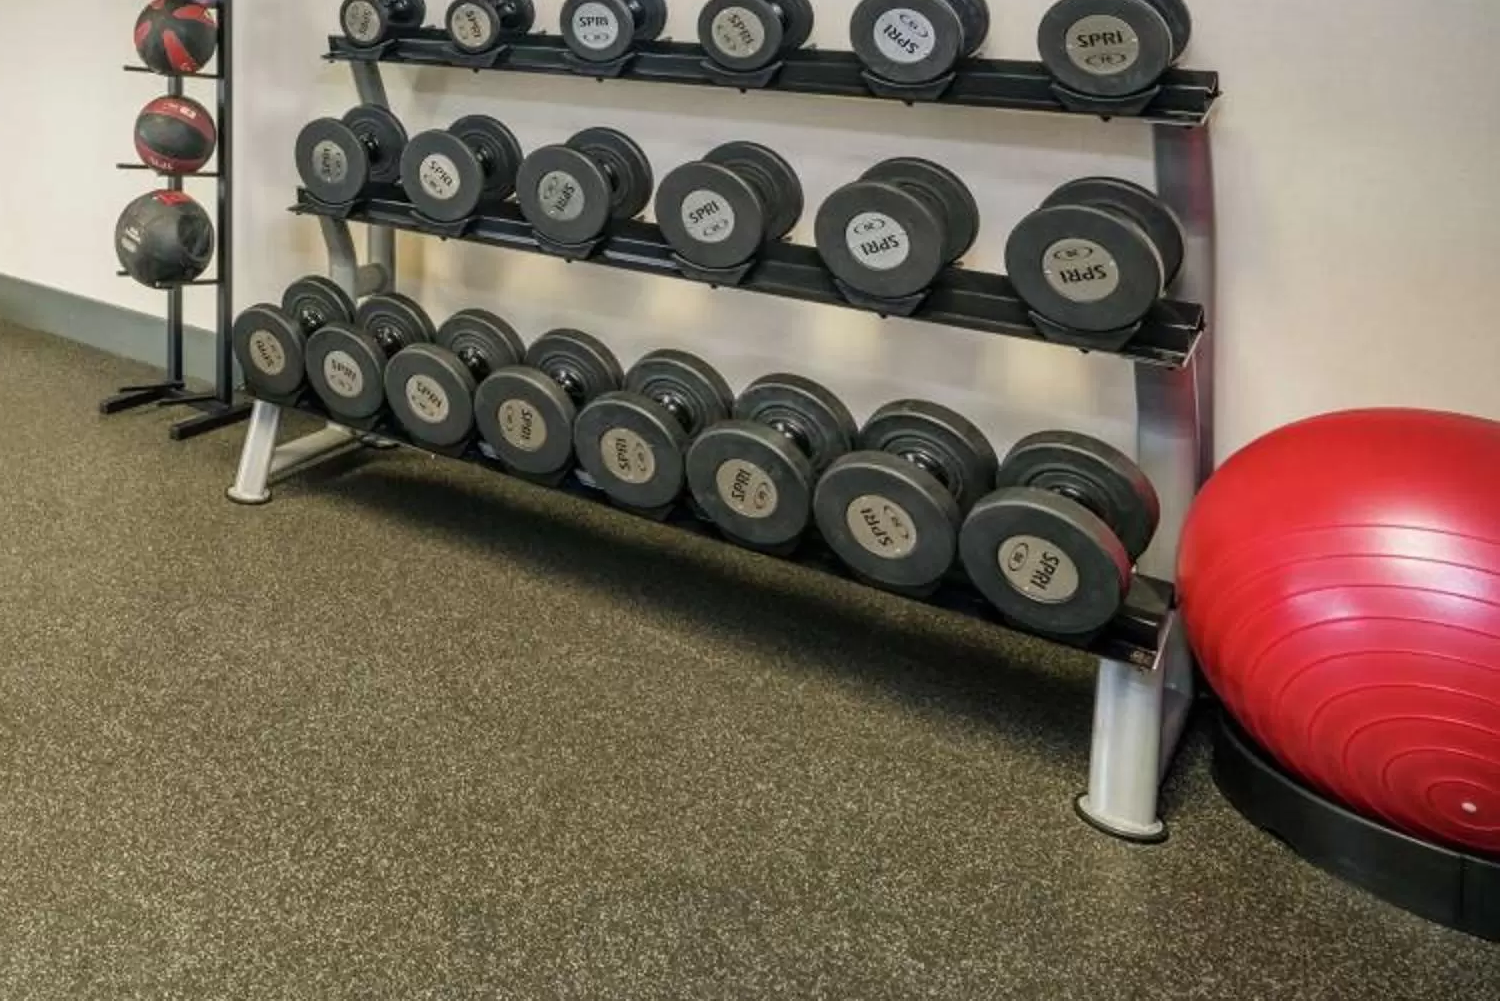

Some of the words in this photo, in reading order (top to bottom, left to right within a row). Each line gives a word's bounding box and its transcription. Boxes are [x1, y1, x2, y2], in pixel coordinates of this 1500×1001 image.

[579, 15, 610, 28] SPRI
[883, 24, 919, 54] SPRI
[1077, 30, 1123, 48] SPRI
[555, 182, 576, 212] SPRI
[690, 200, 720, 224] SPRI
[860, 234, 900, 256] SPRI
[1059, 264, 1107, 284] SPRI
[520, 408, 533, 440] SPRI
[615, 438, 631, 472] SPRI
[731, 468, 751, 502] SPRI
[860, 507, 894, 546] SPRI
[1030, 550, 1060, 590] SPRI
